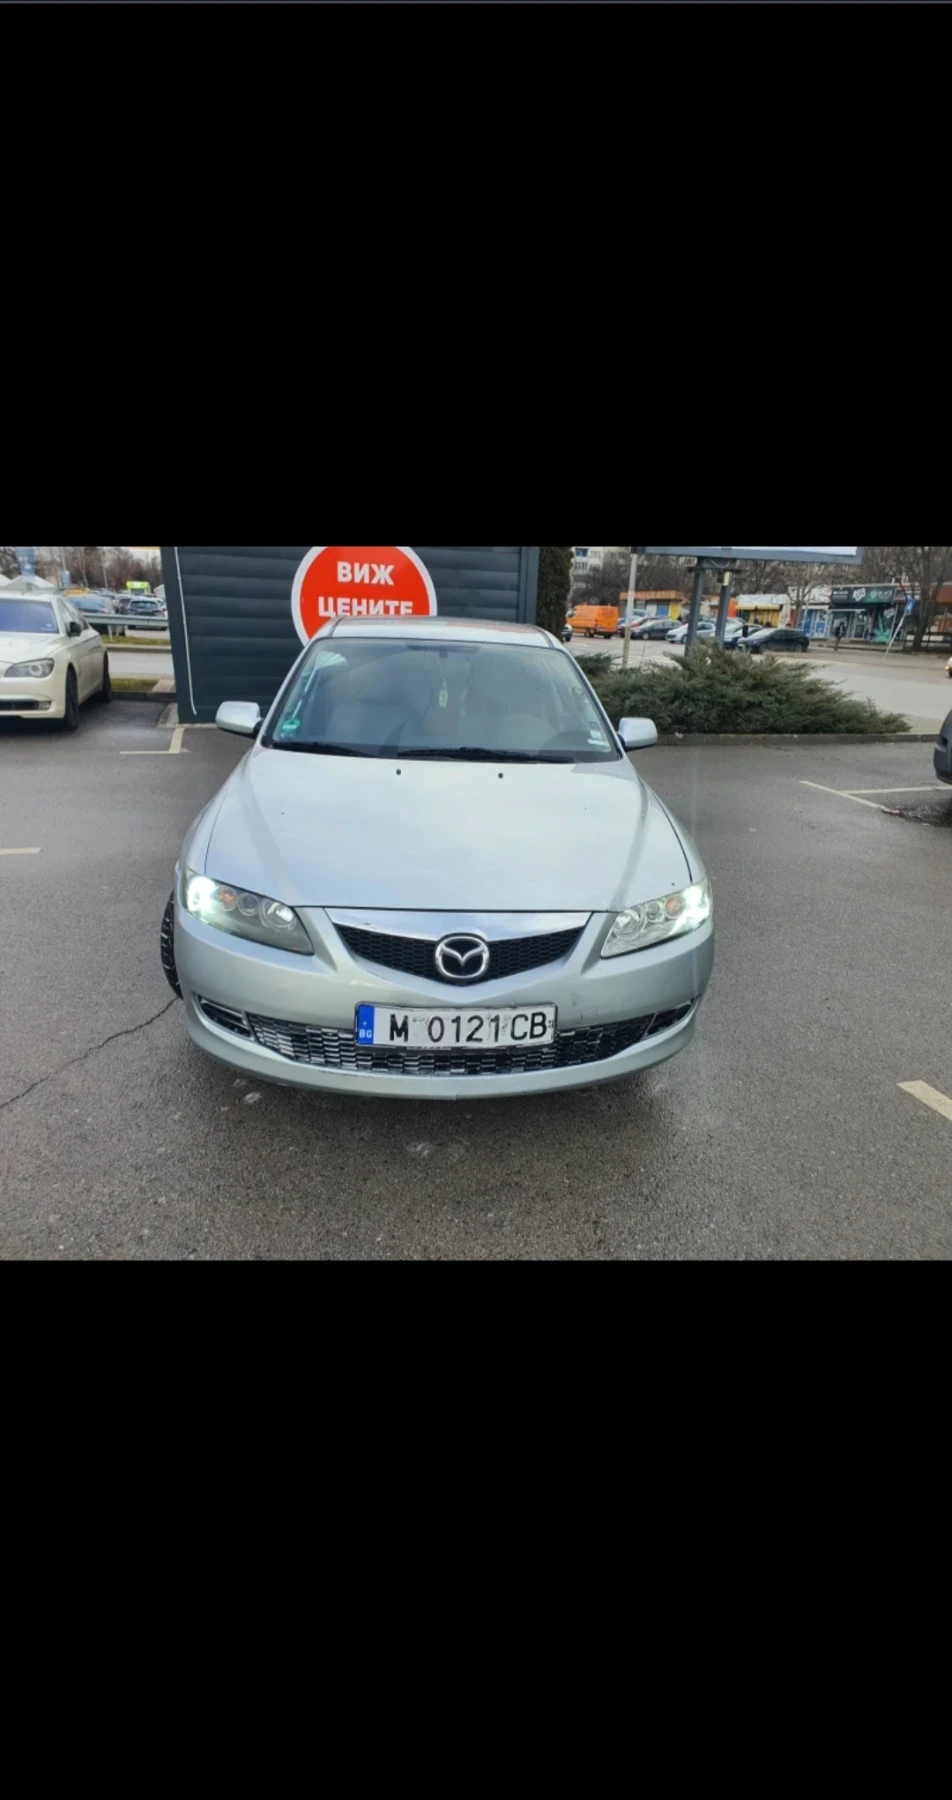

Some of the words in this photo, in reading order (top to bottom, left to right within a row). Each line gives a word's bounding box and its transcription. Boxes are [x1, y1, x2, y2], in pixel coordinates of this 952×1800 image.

[337, 561, 394, 585] ВИЖ
[318, 596, 413, 617] ЦЕНИТЕ
[359, 1029, 372, 1038] BG
[389, 1014, 409, 1043] M
